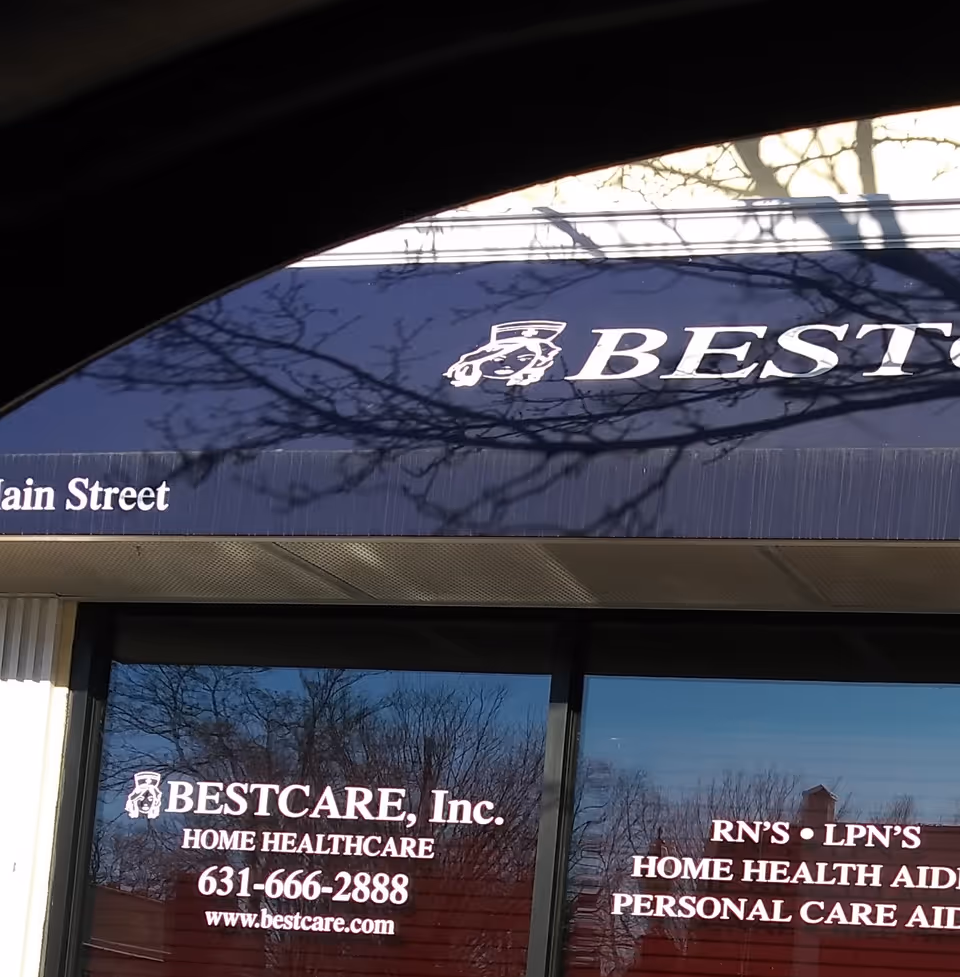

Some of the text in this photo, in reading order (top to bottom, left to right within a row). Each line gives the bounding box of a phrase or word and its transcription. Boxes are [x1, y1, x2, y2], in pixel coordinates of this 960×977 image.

[65, 477, 171, 511] Street
[165, 780, 504, 828] BESTCARE, Inc.
[181, 828, 435, 859] HOME HEALTHCARE
[711, 819, 921, 849] RN'S LPN'S
[198, 865, 409, 904] 631-666-2888
[631, 855, 734, 881] HOME
[741, 859, 884, 887] HEALTH
[205, 908, 395, 935] www.bestcare.com
[611, 893, 793, 923] PERSONAL
[799, 900, 898, 927] CARE
